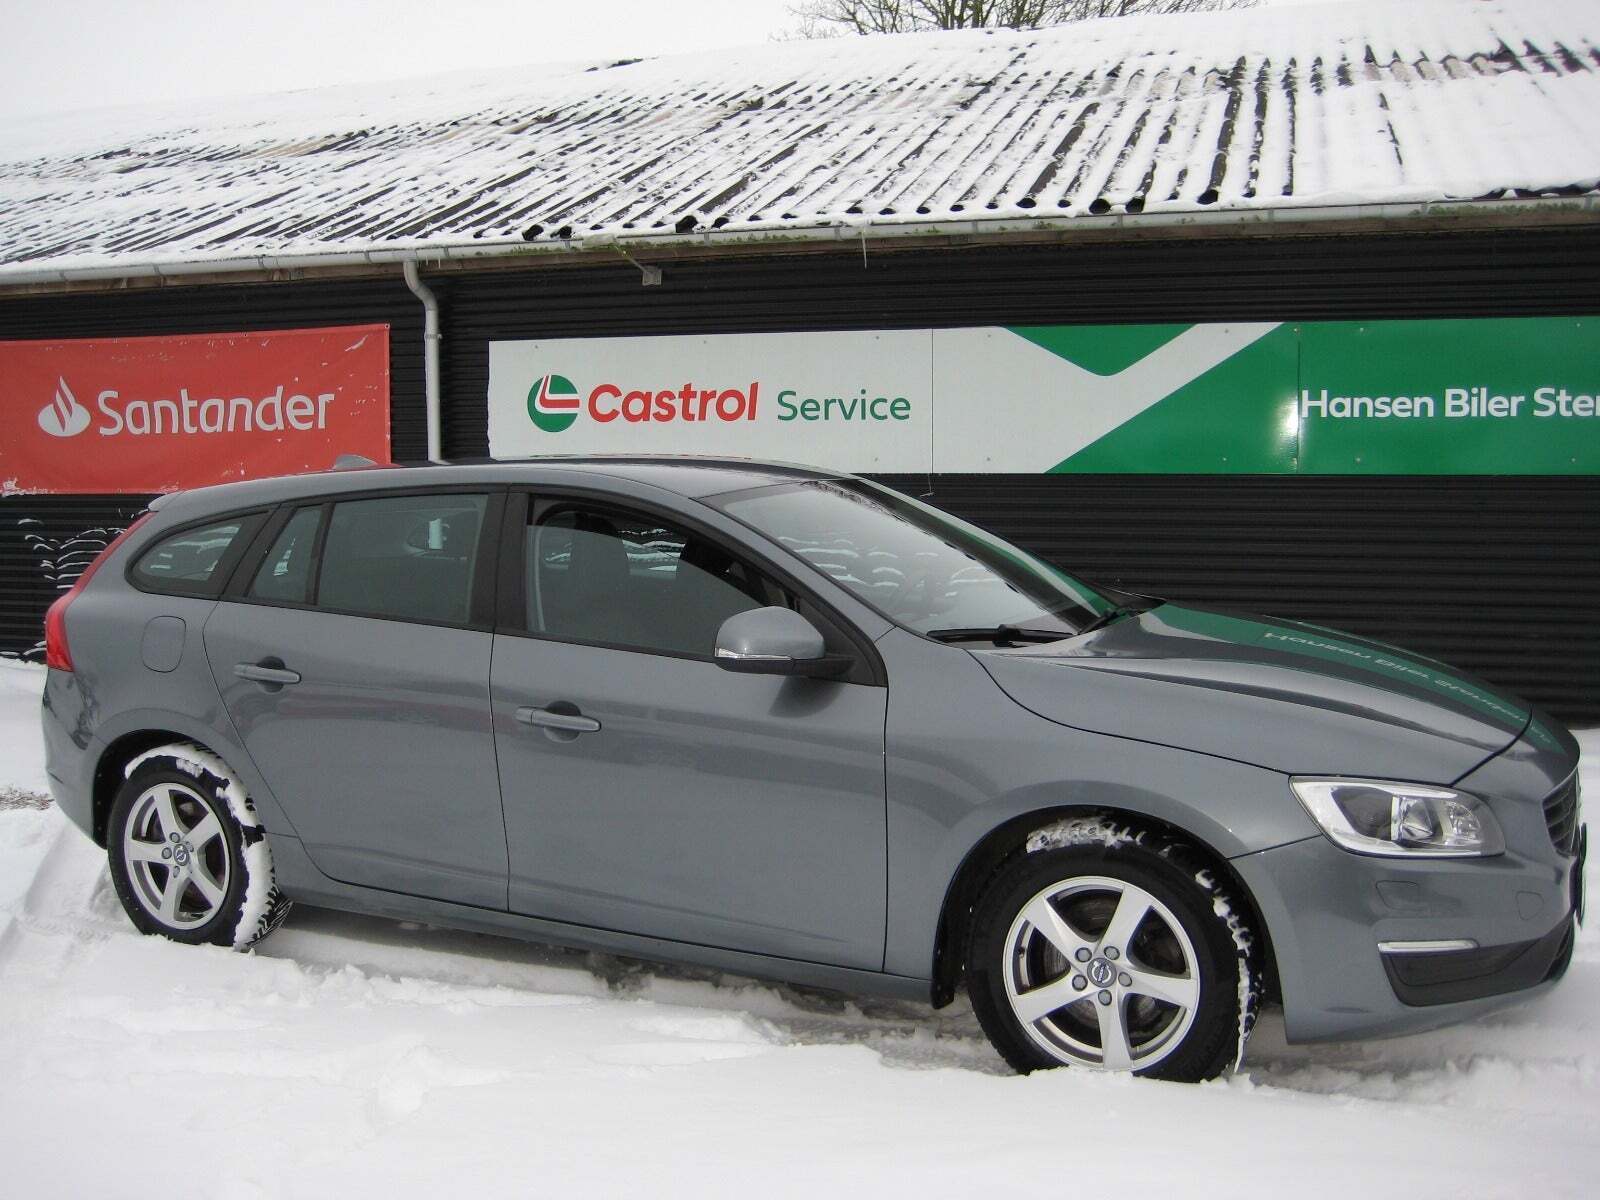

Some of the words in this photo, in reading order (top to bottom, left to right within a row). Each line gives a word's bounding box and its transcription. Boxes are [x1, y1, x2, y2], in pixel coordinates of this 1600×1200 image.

[97, 385, 335, 437] Santander
[587, 381, 760, 423] Castrol
[777, 388, 911, 421] Service
[1301, 389, 1434, 418] Hansen
[1444, 387, 1525, 417] Biler
[1533, 387, 1600, 417] Ste
